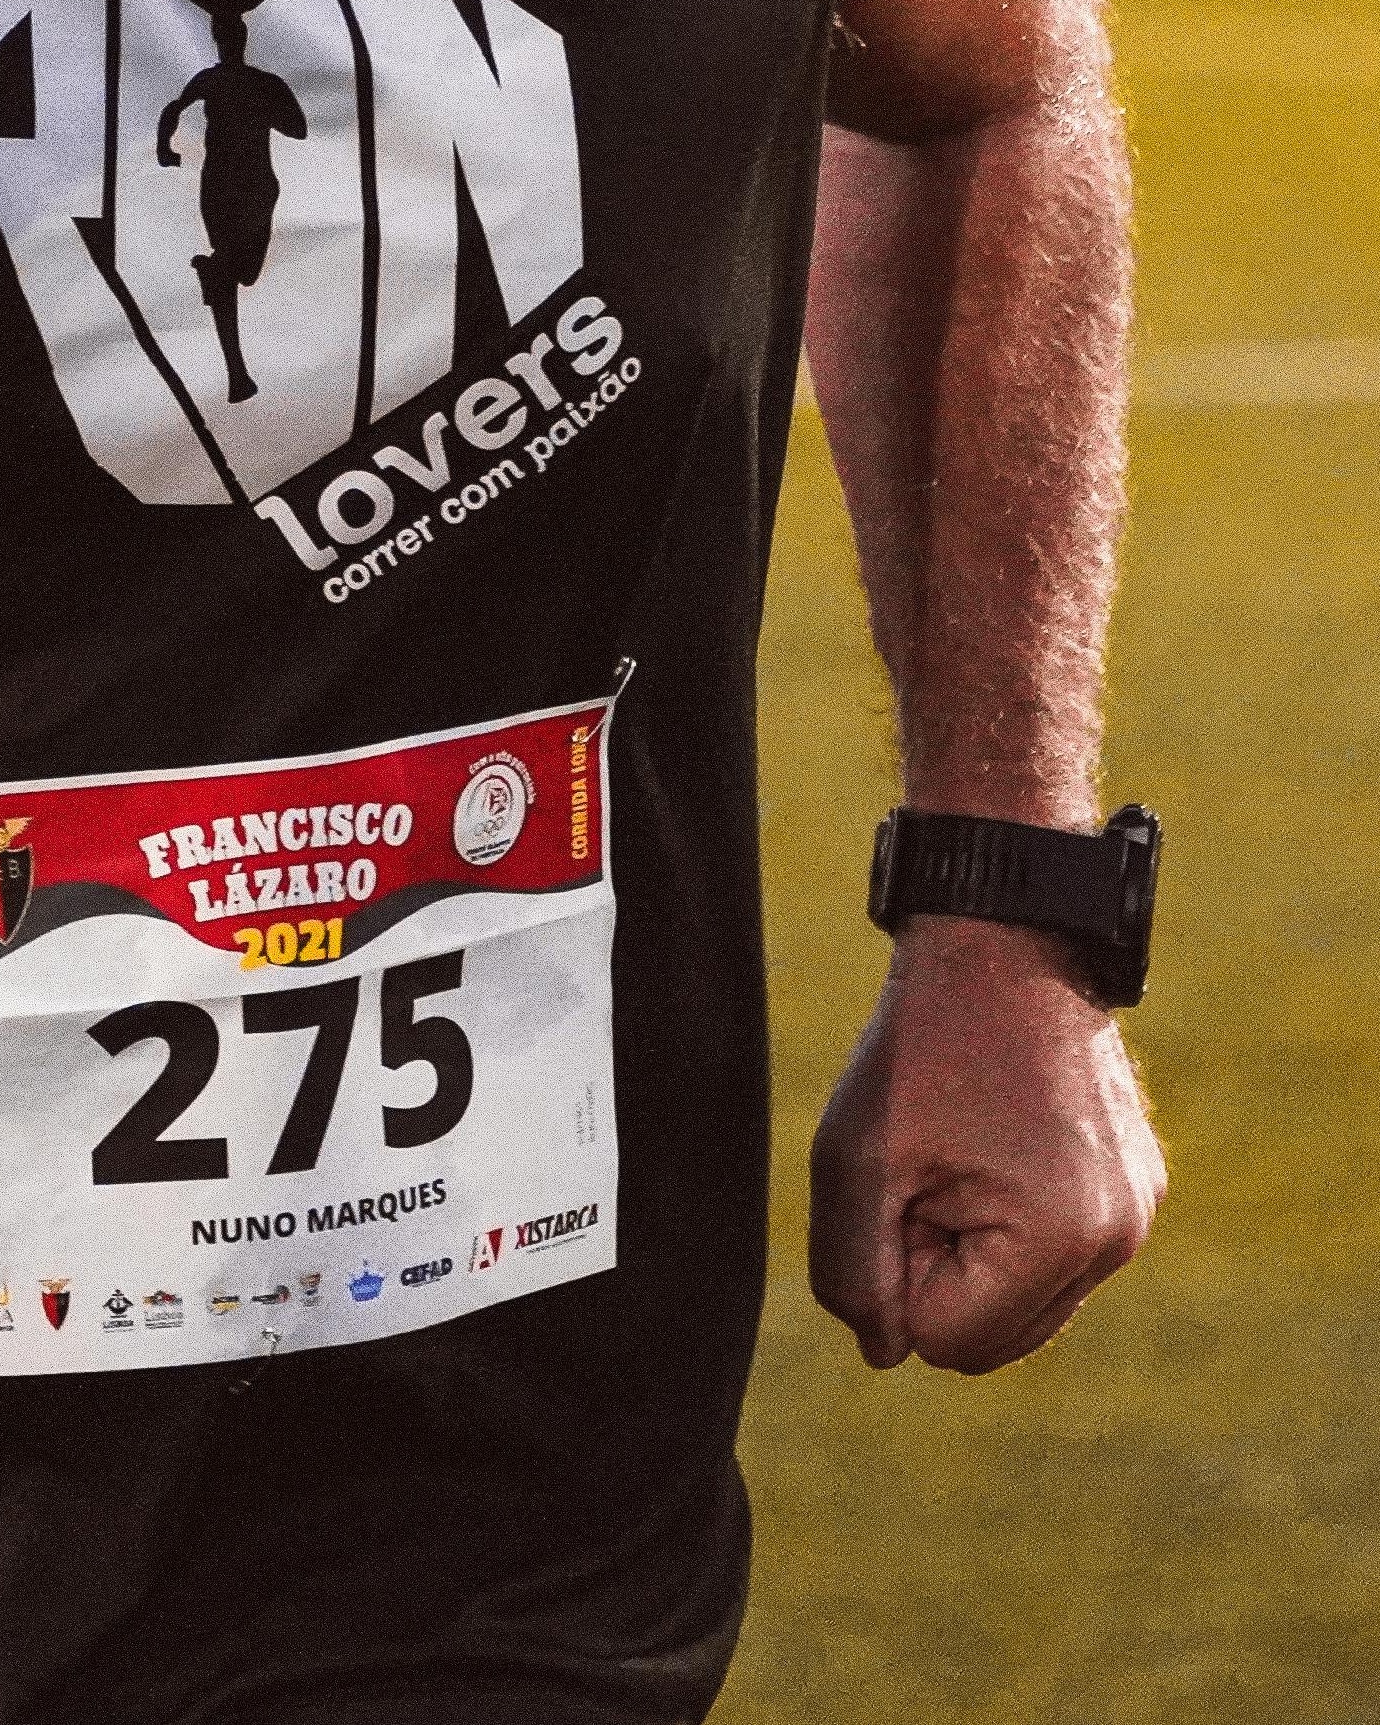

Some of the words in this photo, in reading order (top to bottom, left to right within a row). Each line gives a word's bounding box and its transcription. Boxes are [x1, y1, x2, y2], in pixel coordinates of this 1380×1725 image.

[253, 296, 623, 571] lovers
[322, 515, 435, 603] correr
[440, 458, 526, 524] com
[524, 357, 642, 473] paixão
[138, 803, 413, 879] FRANCISCO
[571, 777, 589, 860] CORRIDA
[187, 858, 377, 923] LÁZARO
[232, 917, 343, 972] 2021
[86, 949, 474, 1186] 275
[191, 1211, 297, 1246] NUNO
[307, 1178, 448, 1234] MARQUES
[514, 1203, 599, 1250] XISTARCA
